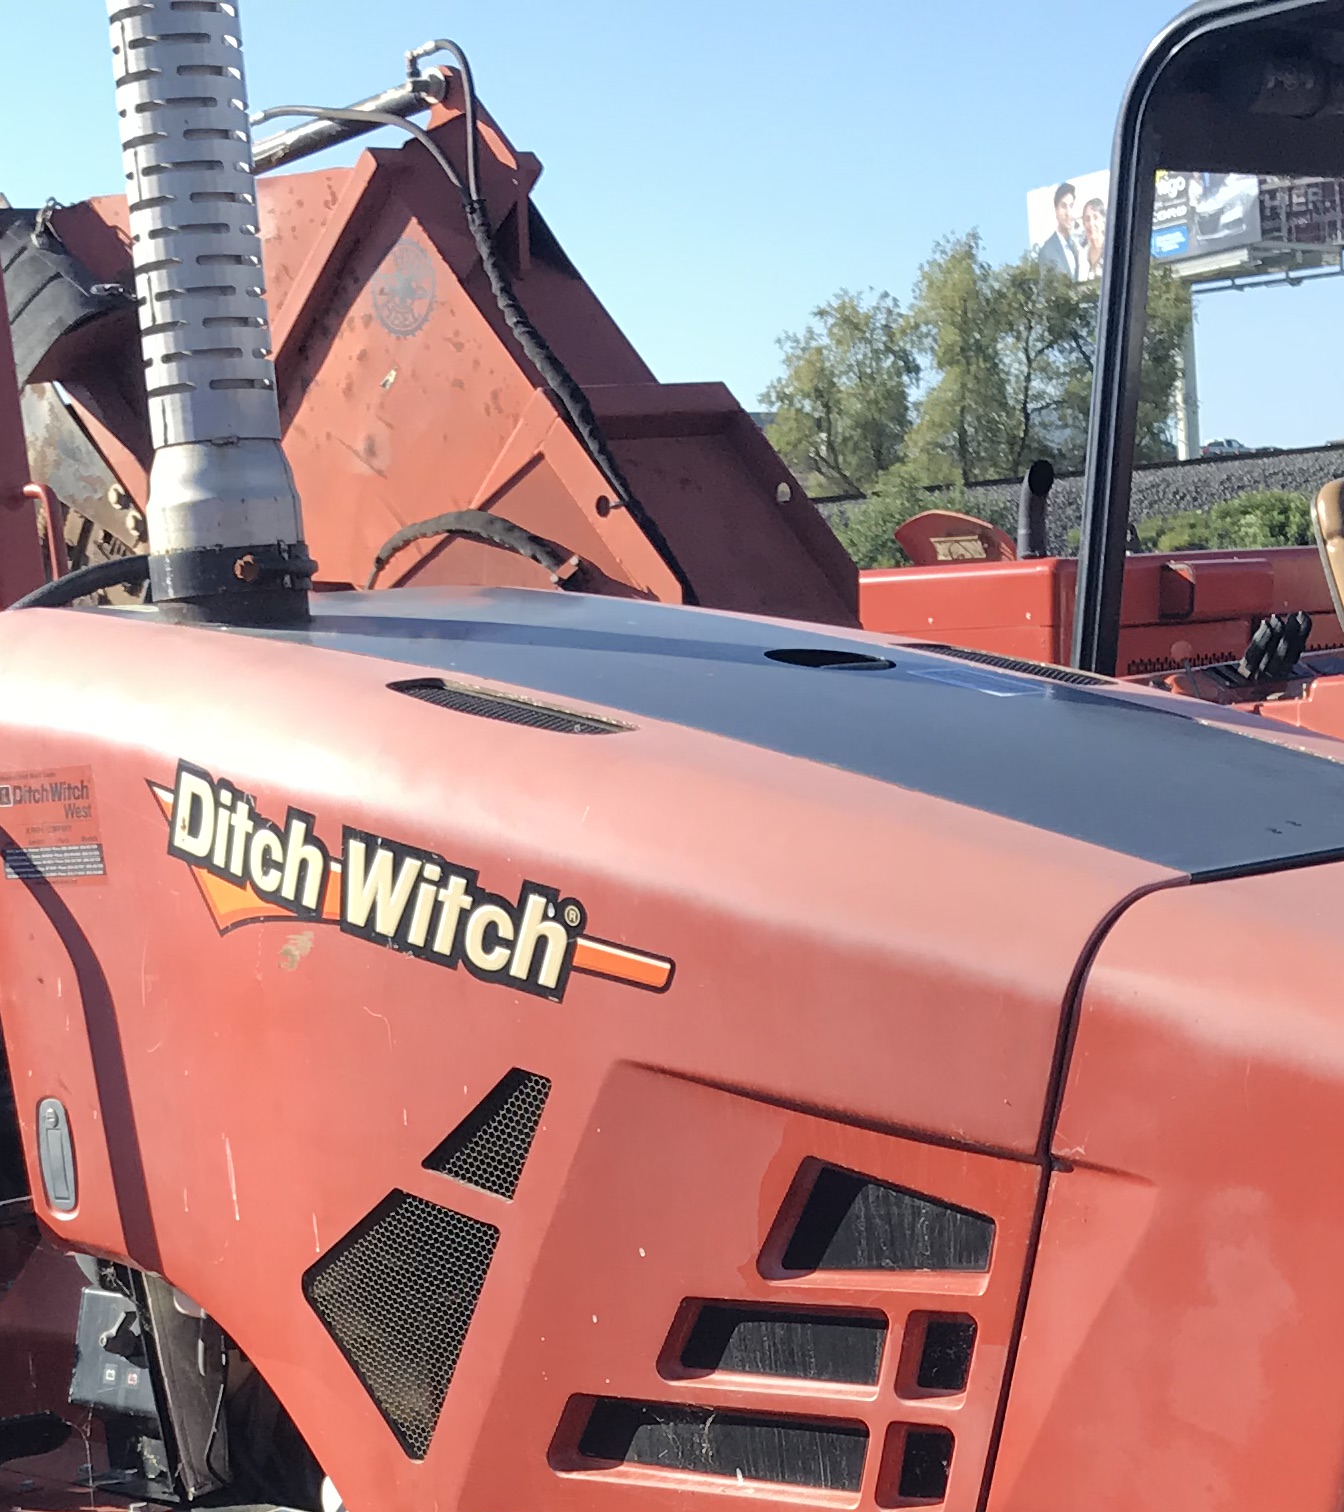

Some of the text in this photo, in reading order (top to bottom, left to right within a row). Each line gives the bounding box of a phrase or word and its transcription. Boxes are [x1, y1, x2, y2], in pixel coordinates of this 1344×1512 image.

[13, 780, 89, 805] Ditch Witch
[64, 803, 92, 819] West
[173, 770, 568, 989] Ditch Witch
